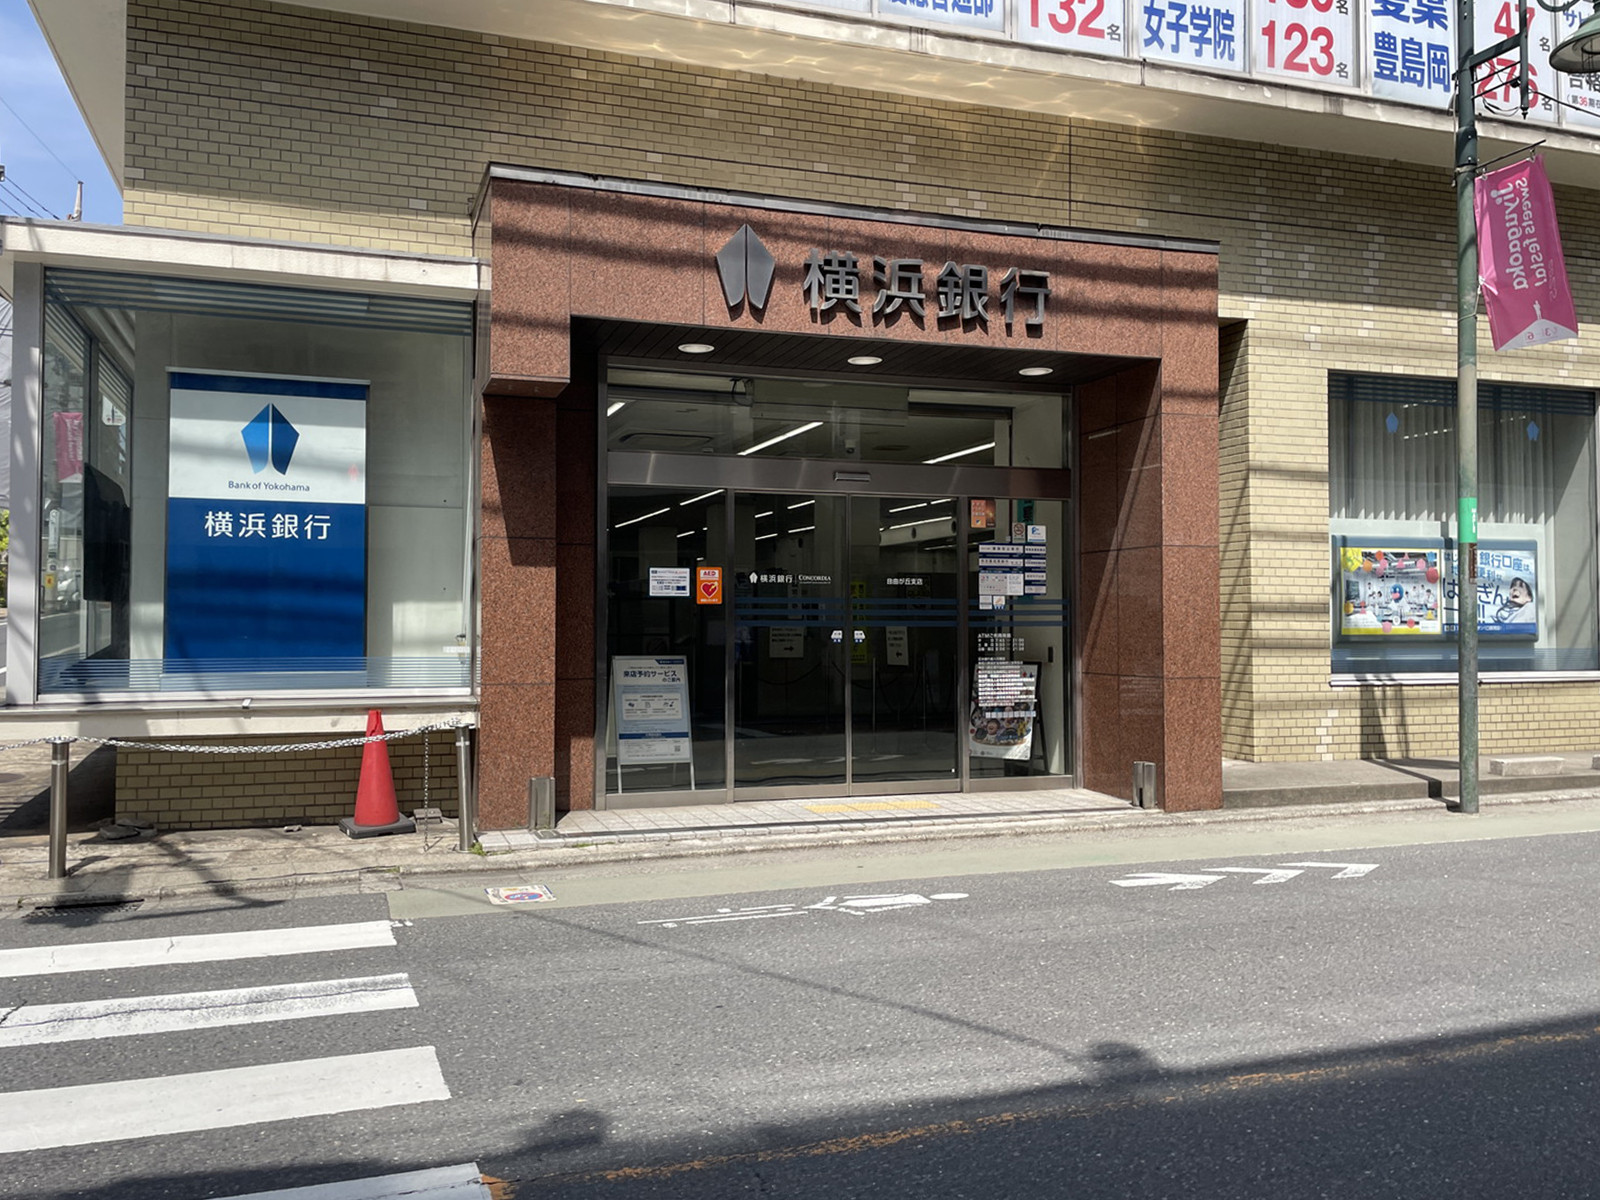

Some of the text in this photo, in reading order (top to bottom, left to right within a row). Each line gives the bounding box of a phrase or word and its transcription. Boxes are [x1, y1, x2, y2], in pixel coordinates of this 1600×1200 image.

[1143, 1, 1235, 62] 女子学院
[1373, 31, 1450, 93] 豊島岡
[803, 247, 1051, 325] 横浜銀行
[228, 480, 310, 492] Bank of Yokohama
[204, 511, 331, 540] 横浜銀行
[760, 574, 793, 583] 横浜銀行
